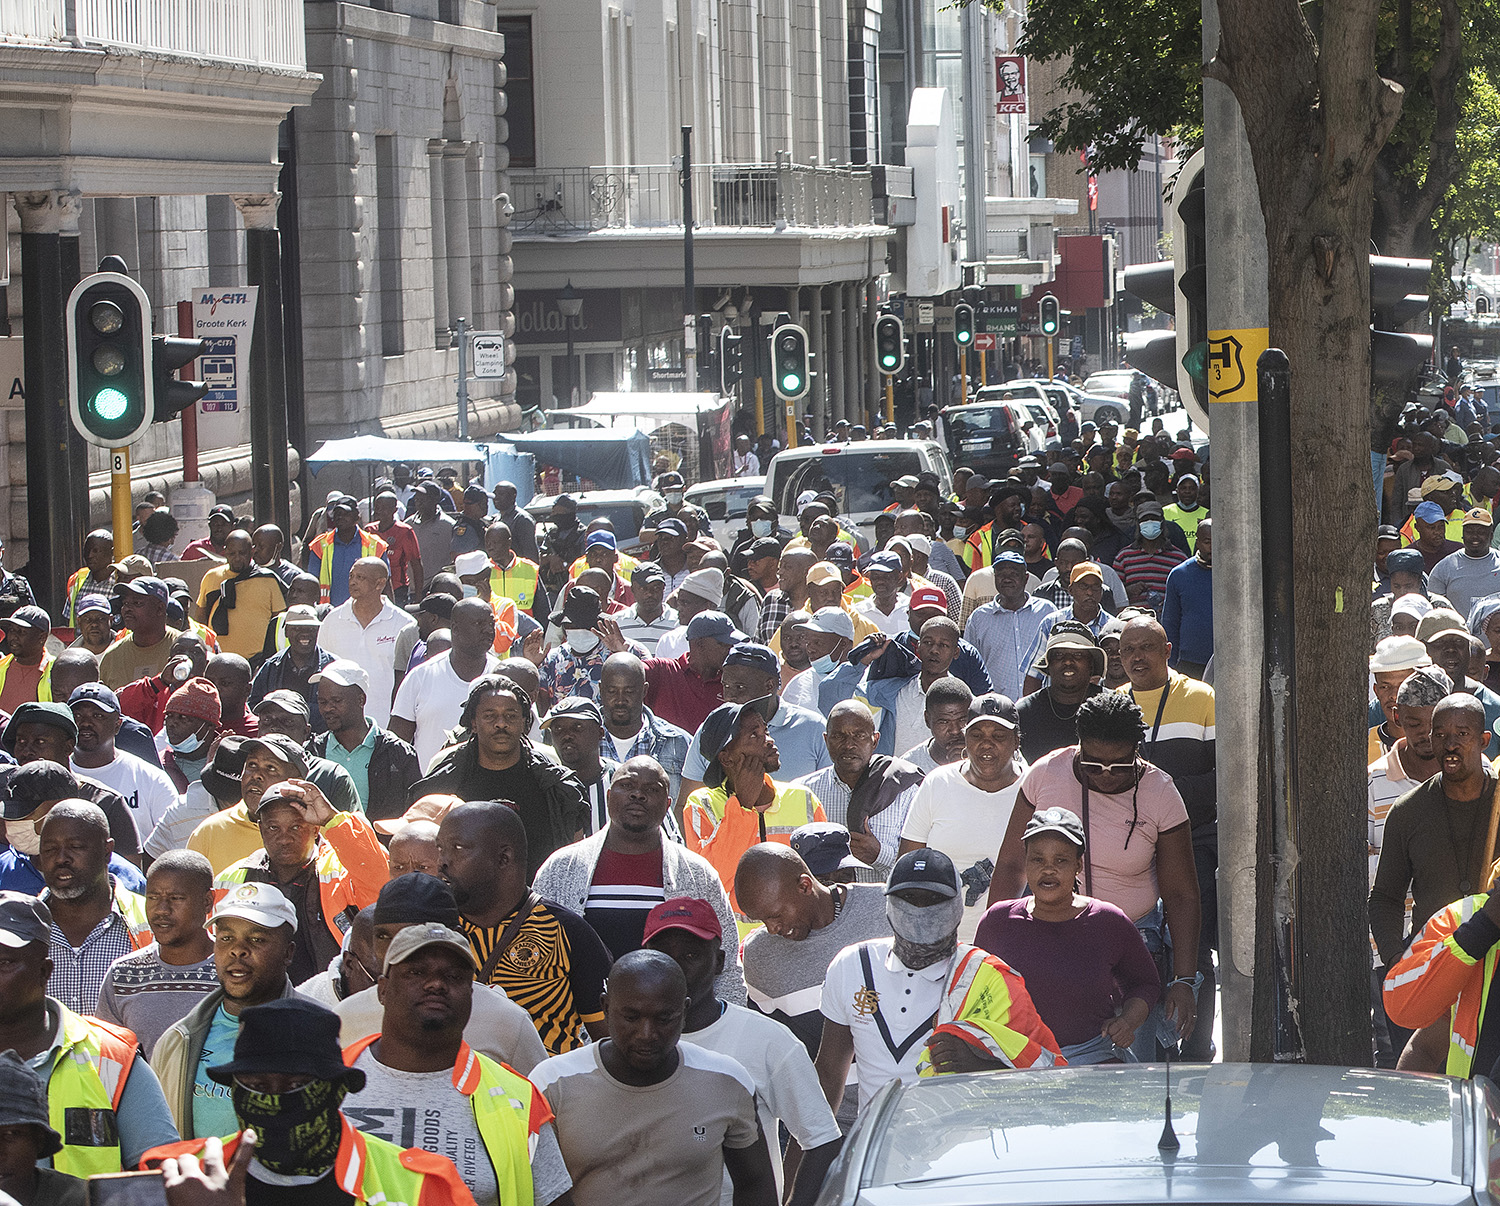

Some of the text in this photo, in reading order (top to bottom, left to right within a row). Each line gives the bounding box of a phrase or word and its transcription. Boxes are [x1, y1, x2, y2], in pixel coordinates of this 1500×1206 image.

[1000, 103, 1025, 112] KFC
[196, 320, 248, 328] Groote Kerk
[475, 360, 503, 368] Clamping
[1215, 369, 1222, 380] 3
[206, 403, 216, 411] 107
[114, 455, 122, 470] 8
[514, 942, 536, 950] KAIZER
[423, 1108, 442, 1154] GOODS
[694, 1126, 706, 1136] U
[464, 1137, 477, 1176] RIVETED
